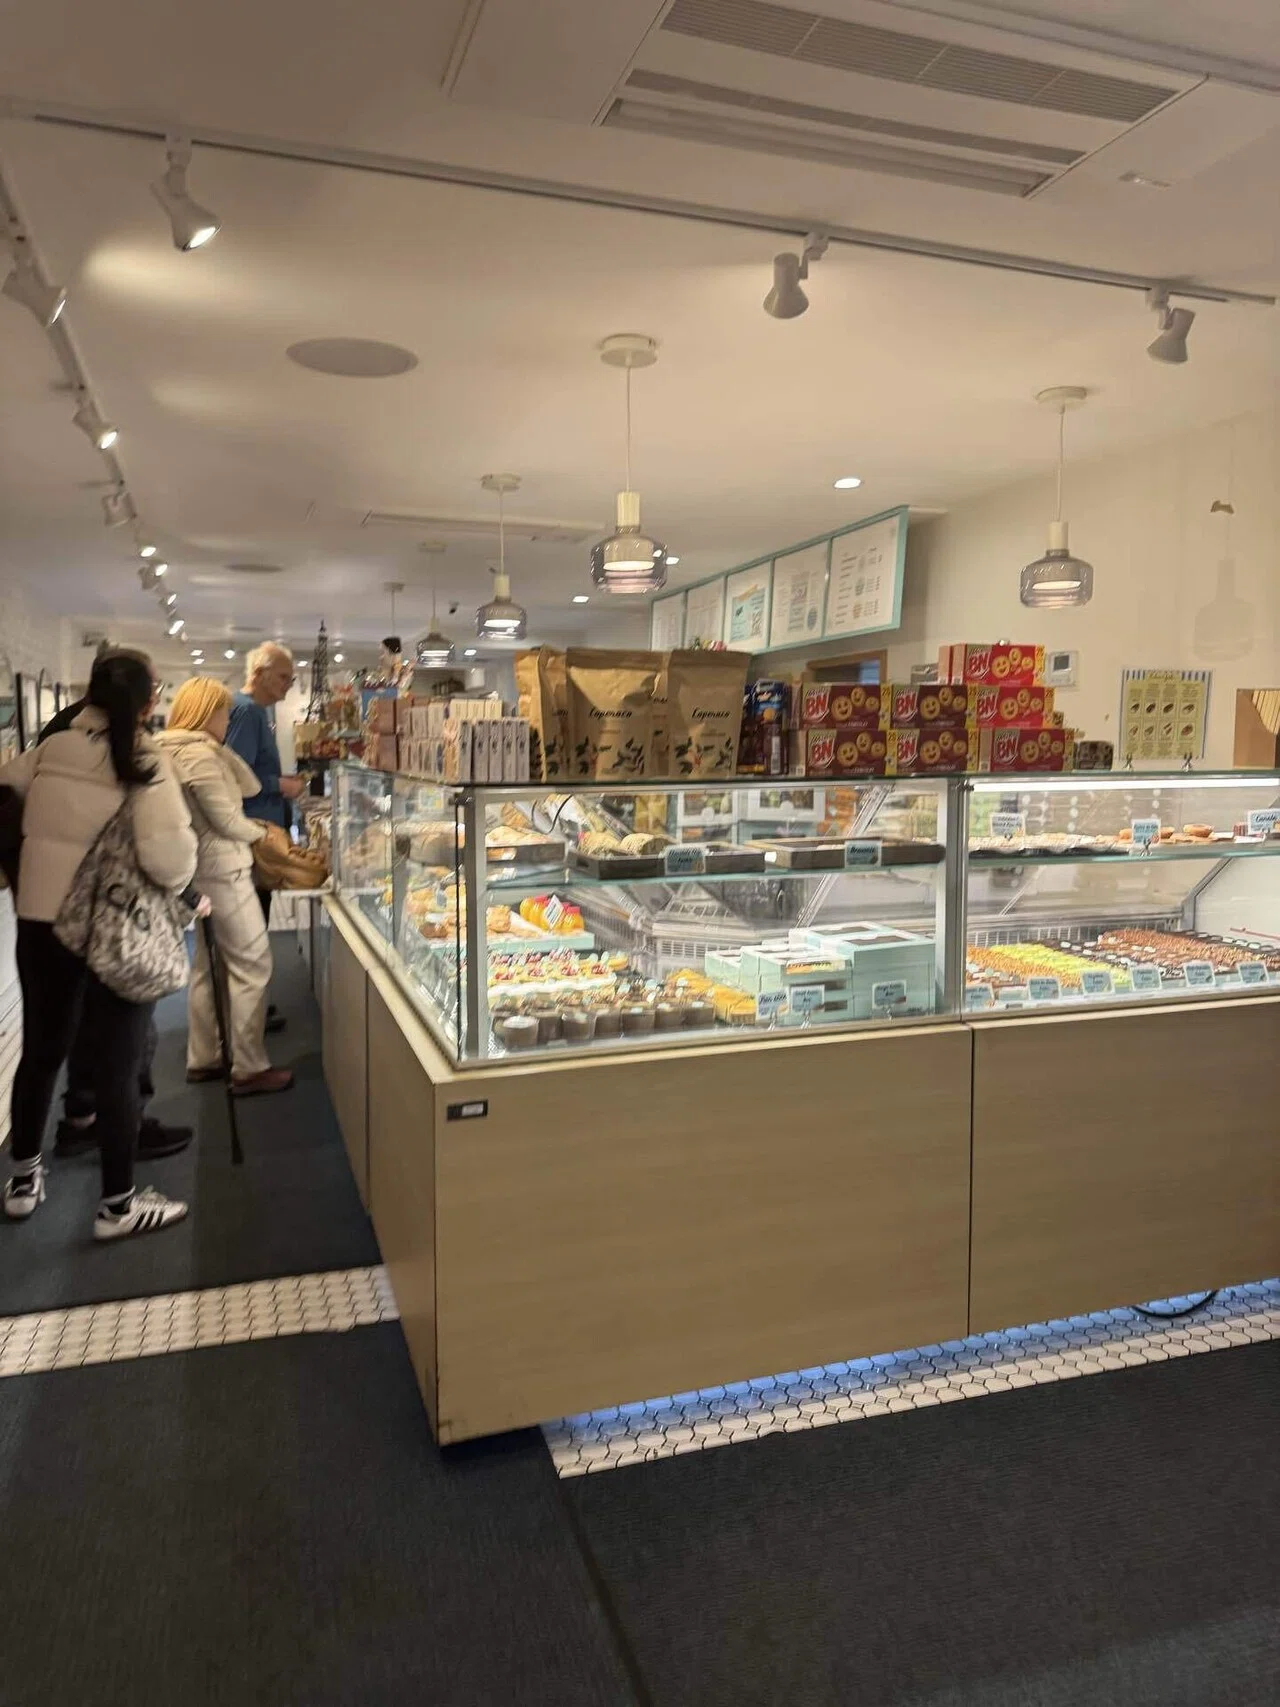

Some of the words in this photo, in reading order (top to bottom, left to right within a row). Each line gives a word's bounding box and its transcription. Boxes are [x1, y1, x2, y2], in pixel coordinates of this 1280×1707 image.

[968, 652, 989, 673] BN
[806, 694, 828, 716] BN
[896, 694, 917, 715] BN
[811, 740, 833, 761] BN
